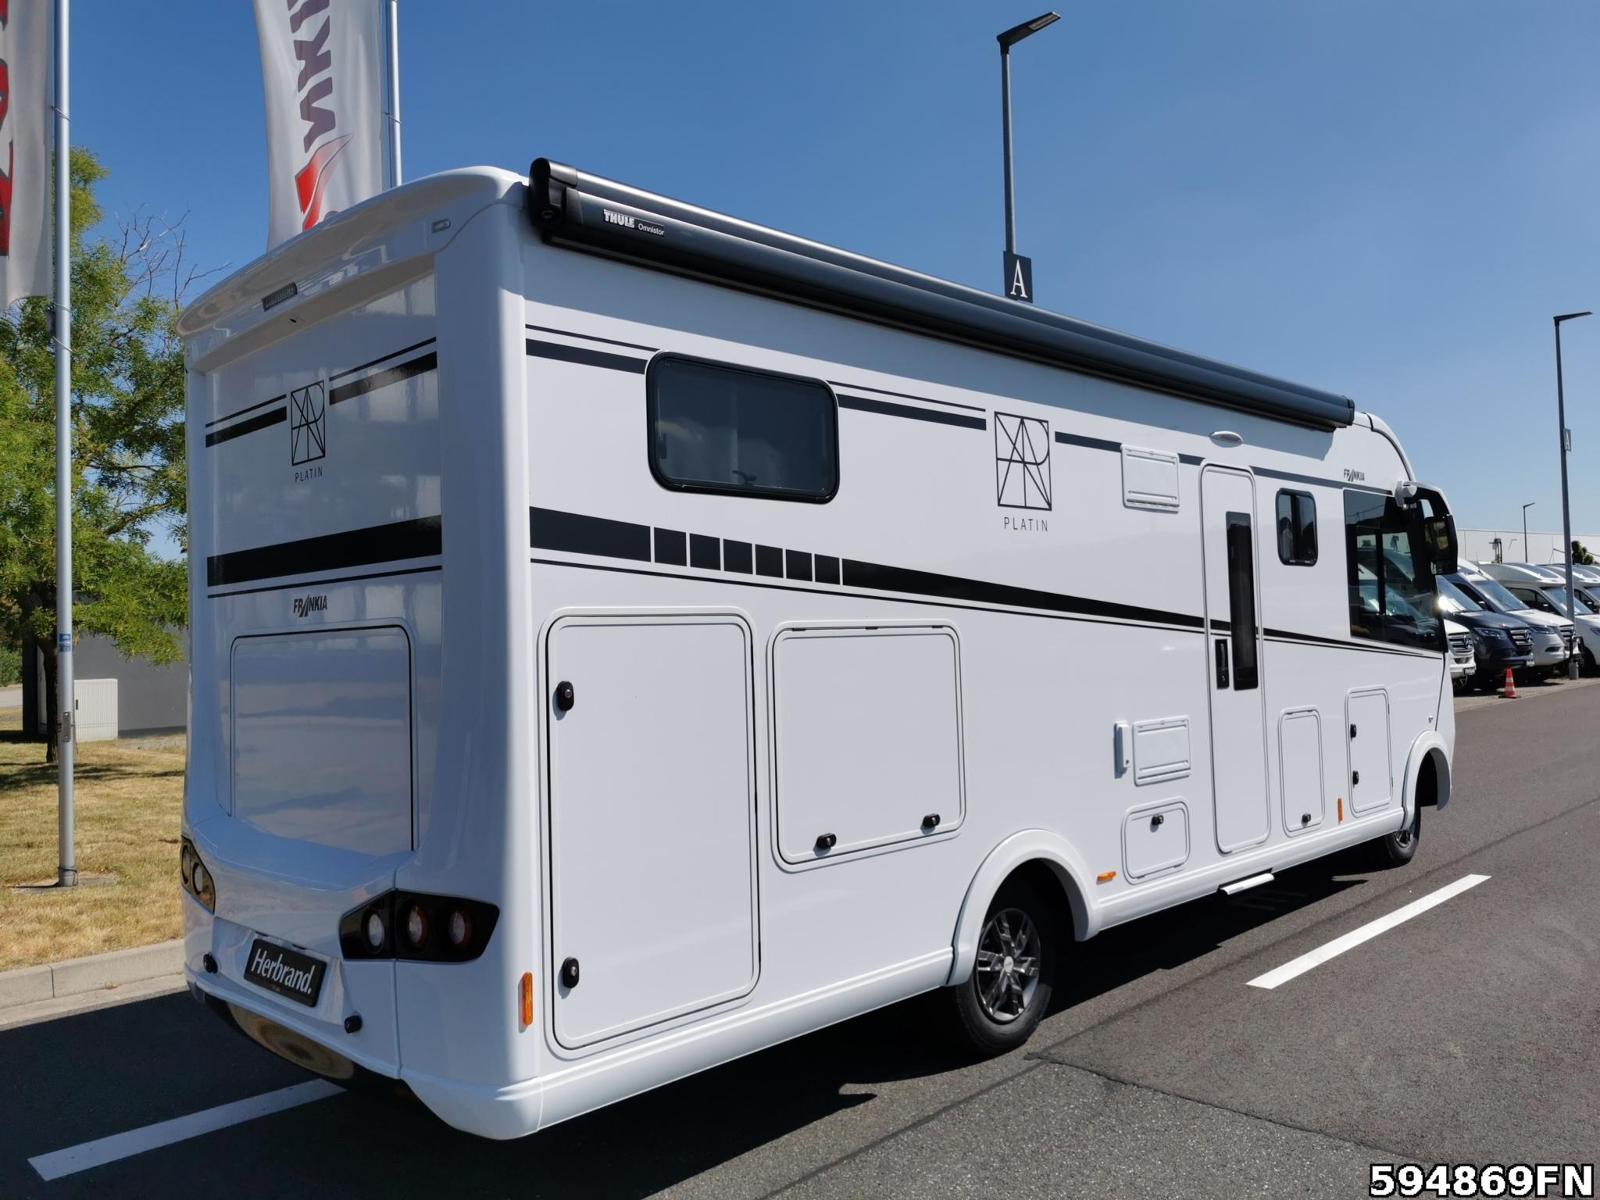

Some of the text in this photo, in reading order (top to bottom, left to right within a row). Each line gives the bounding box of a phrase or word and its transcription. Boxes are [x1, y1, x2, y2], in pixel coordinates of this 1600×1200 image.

[603, 208, 665, 236] THULE Omnistor
[1010, 259, 1028, 298] A
[294, 466, 323, 483] PLATIN
[1004, 516, 1048, 532] PLATIN
[293, 594, 328, 617] FRANKIA
